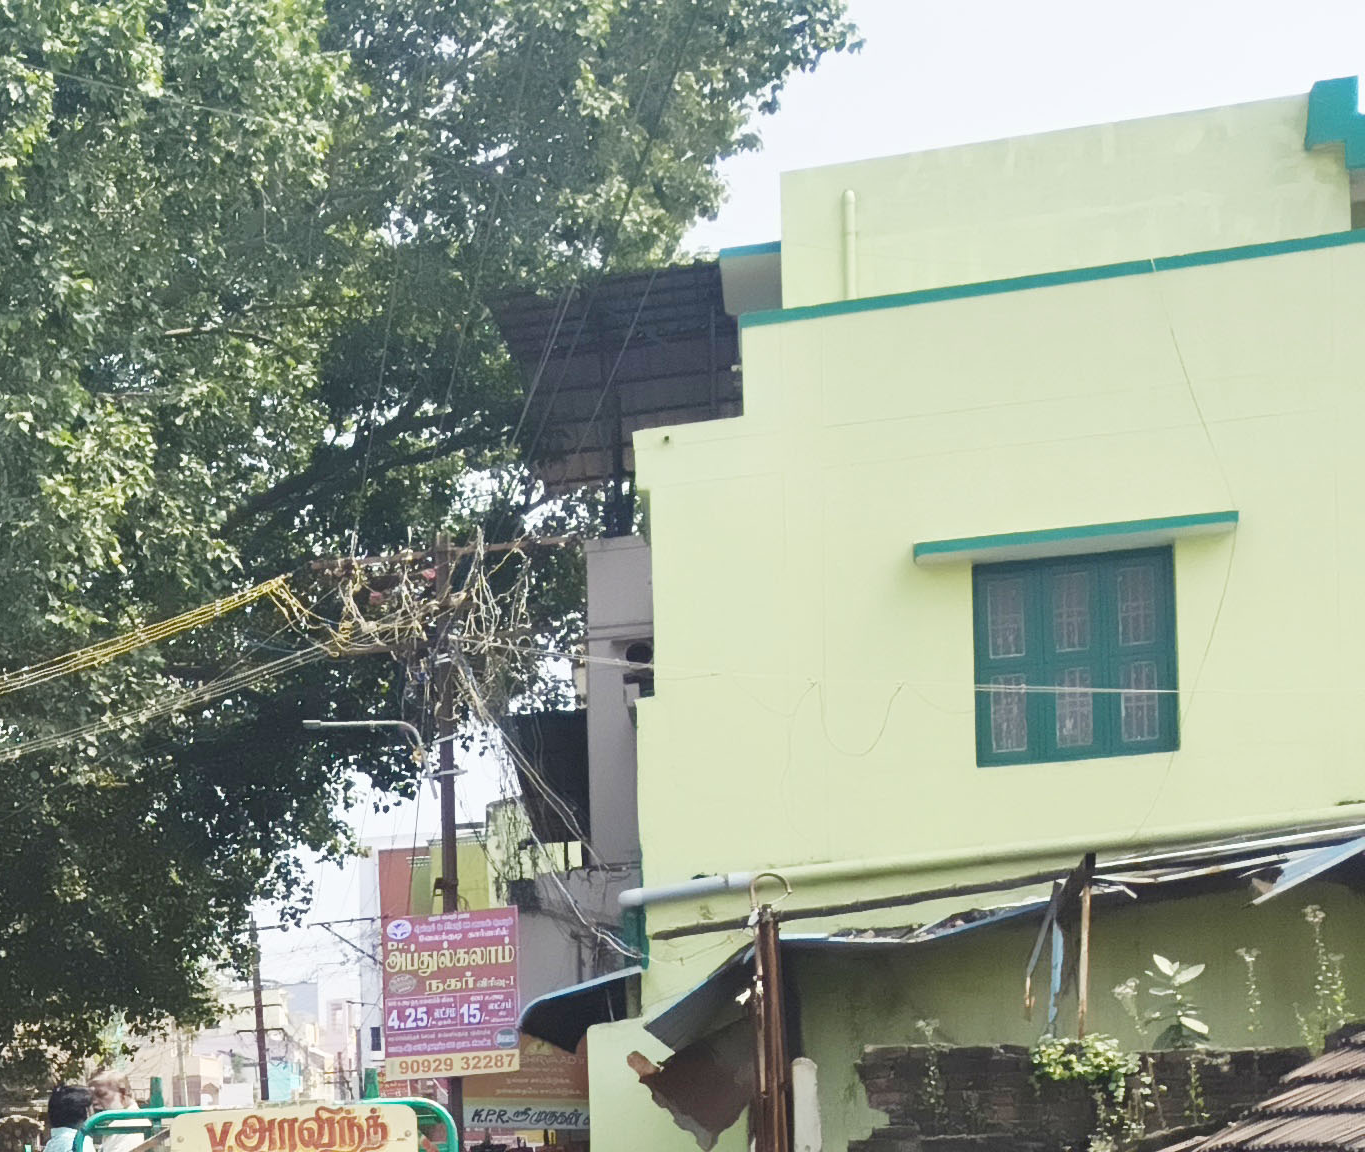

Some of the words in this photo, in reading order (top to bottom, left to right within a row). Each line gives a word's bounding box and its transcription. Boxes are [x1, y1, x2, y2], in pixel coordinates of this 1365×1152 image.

[385, 937, 515, 976] அப்துல்கலாம்
[425, 972, 476, 995] நகர்
[399, 1057, 453, 1075] 90929
[460, 1053, 516, 1071] 32287
